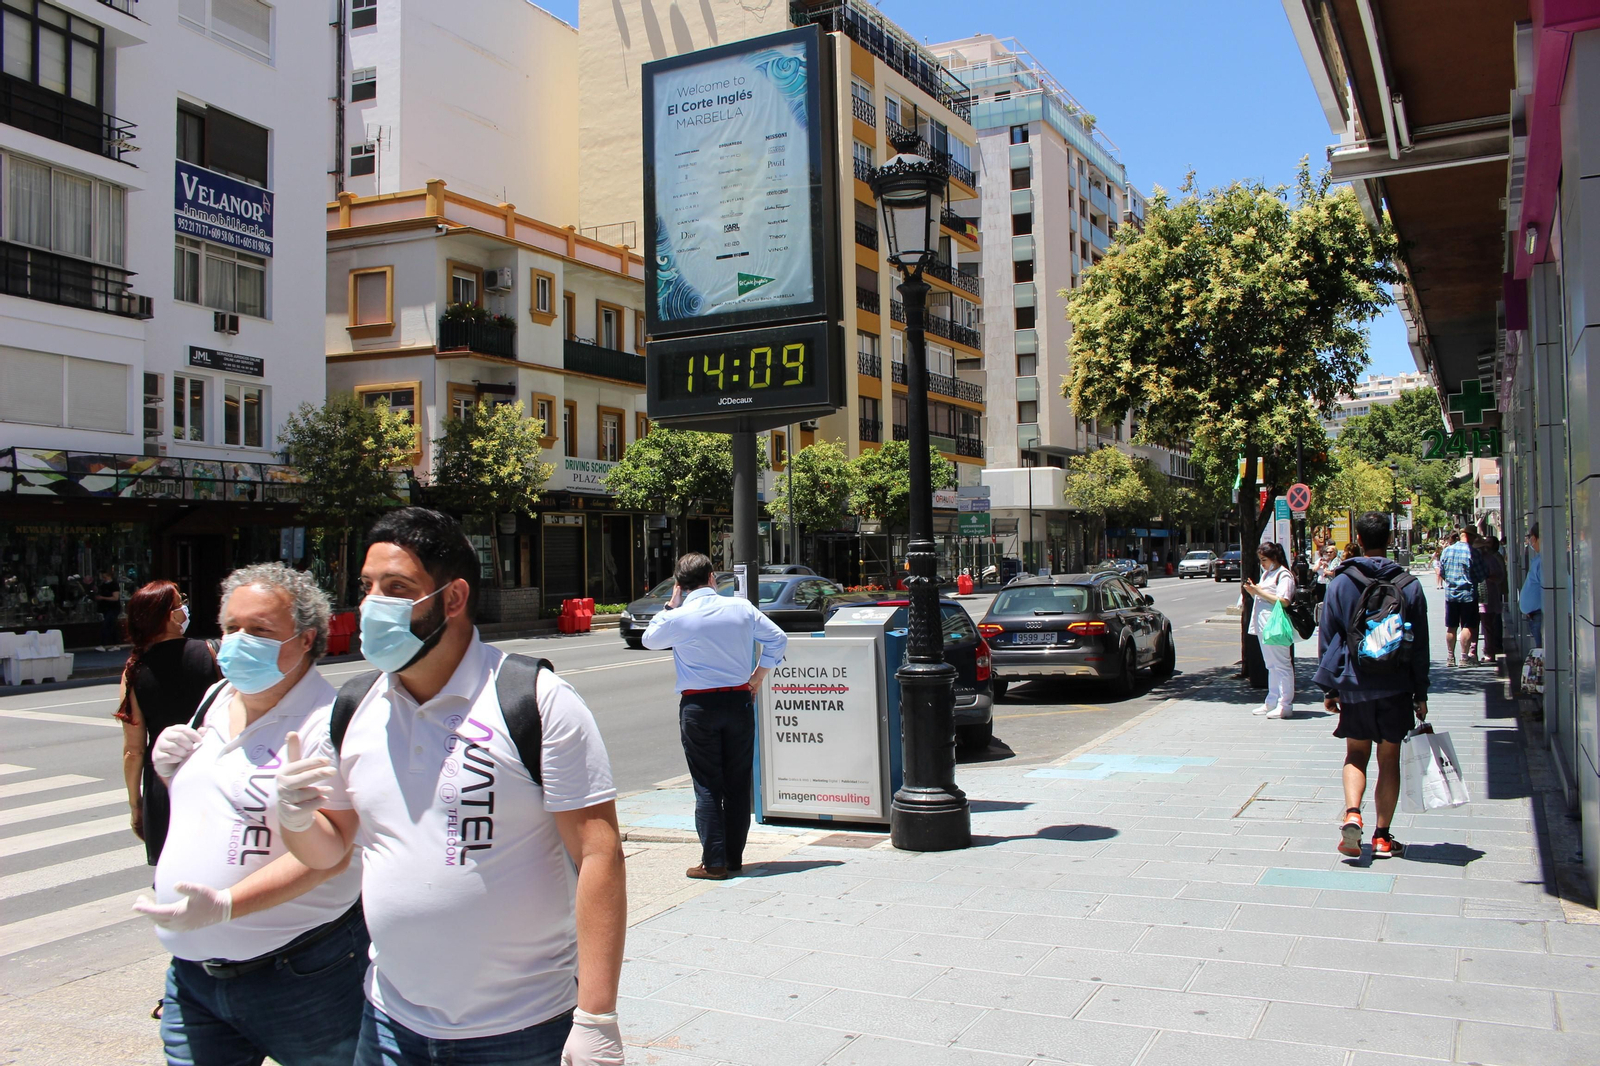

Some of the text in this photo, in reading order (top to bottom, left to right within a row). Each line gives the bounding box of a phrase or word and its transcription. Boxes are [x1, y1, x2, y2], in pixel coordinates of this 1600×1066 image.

[676, 76, 746, 98] Welcome to
[668, 89, 753, 116] El Corte Inglés
[676, 106, 744, 130] MARBELLA
[765, 132, 788, 141] MISSONI
[180, 172, 263, 222] VELANOR
[183, 202, 265, 237] inmobiliaria
[178, 218, 188, 230] 952
[189, 221, 195, 232] 21
[202, 225, 208, 236] 77
[235, 235, 240, 245] 11
[681, 231, 697, 240] Dior
[192, 350, 211, 362] JML
[688, 343, 805, 393] 14:09
[718, 396, 753, 406] JCDecaux
[1422, 427, 1498, 460] 24H
[565, 459, 612, 474] DRIVING SCHOO
[15, 526, 52, 534] NEVADA
[1018, 633, 1038, 642] 9599
[1366, 614, 1403, 653] NIKE
[773, 666, 847, 678] AGENCIA DE
[774, 683, 846, 695] PUBLICIDAD
[775, 700, 844, 711] AUMENTAR
[775, 716, 798, 726] TUS
[776, 732, 824, 743] VENTAS
[778, 790, 870, 806] imagenconsulting
[445, 808, 457, 866] TELECOM
